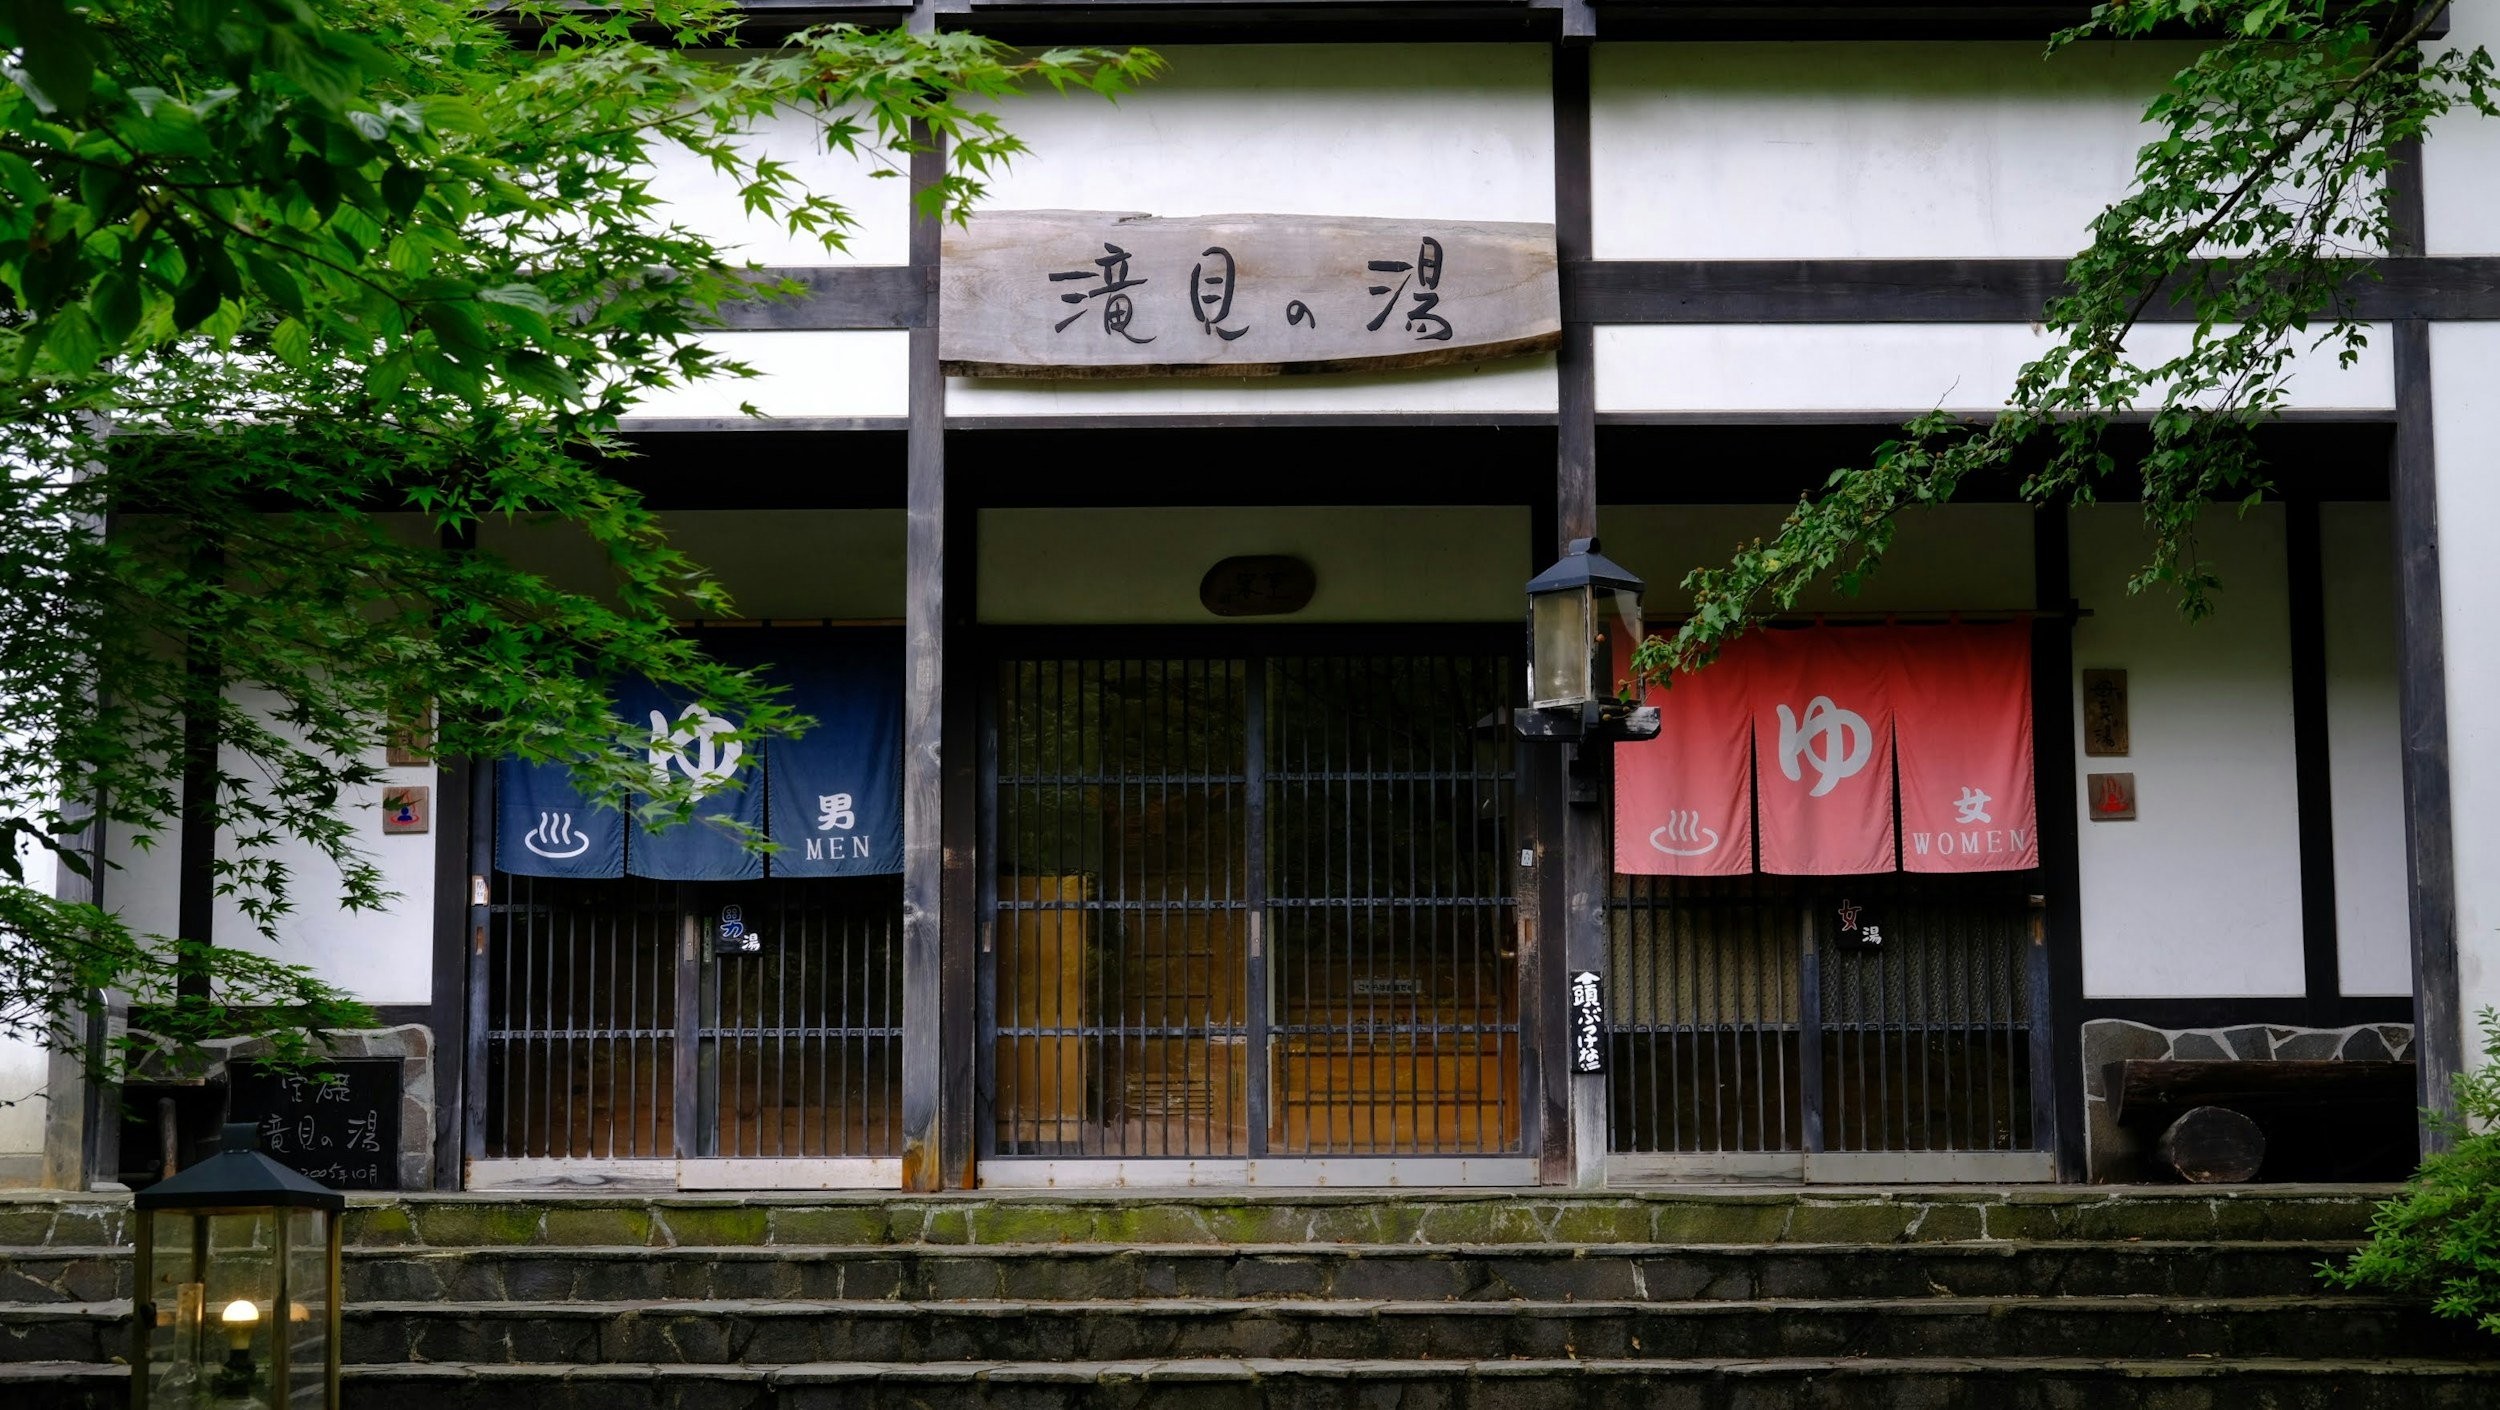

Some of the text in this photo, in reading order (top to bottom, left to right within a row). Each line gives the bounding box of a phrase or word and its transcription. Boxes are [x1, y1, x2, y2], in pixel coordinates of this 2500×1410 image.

[1048, 235, 1453, 344] 滝見の湯
[647, 702, 743, 802] ゆ
[1776, 694, 1873, 799] ゆ
[817, 792, 855, 831] 男
[1953, 786, 1993, 824] 女
[805, 835, 871, 862] MEN
[1912, 827, 2026, 857] WOMEN
